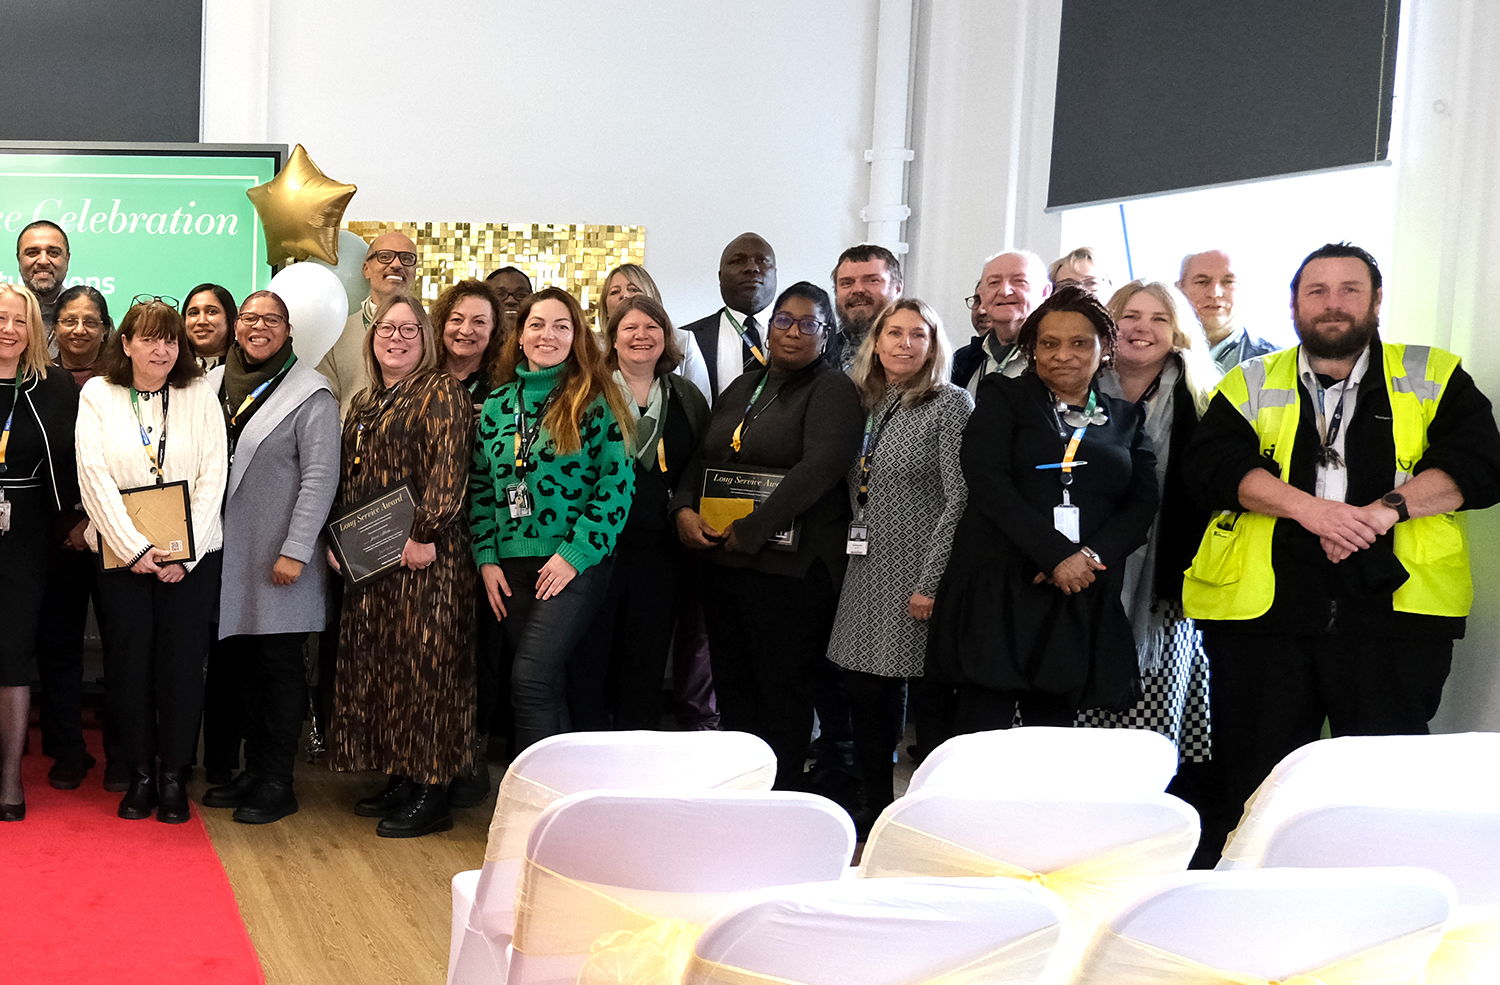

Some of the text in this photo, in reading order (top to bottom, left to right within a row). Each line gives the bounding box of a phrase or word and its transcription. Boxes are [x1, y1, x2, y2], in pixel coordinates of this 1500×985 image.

[33, 198, 239, 236] Celebration
[713, 474, 733, 485] Long
[734, 476, 762, 486] Service
[340, 519, 357, 532] Long
[357, 507, 380, 523] Service
[381, 493, 403, 511] Award
